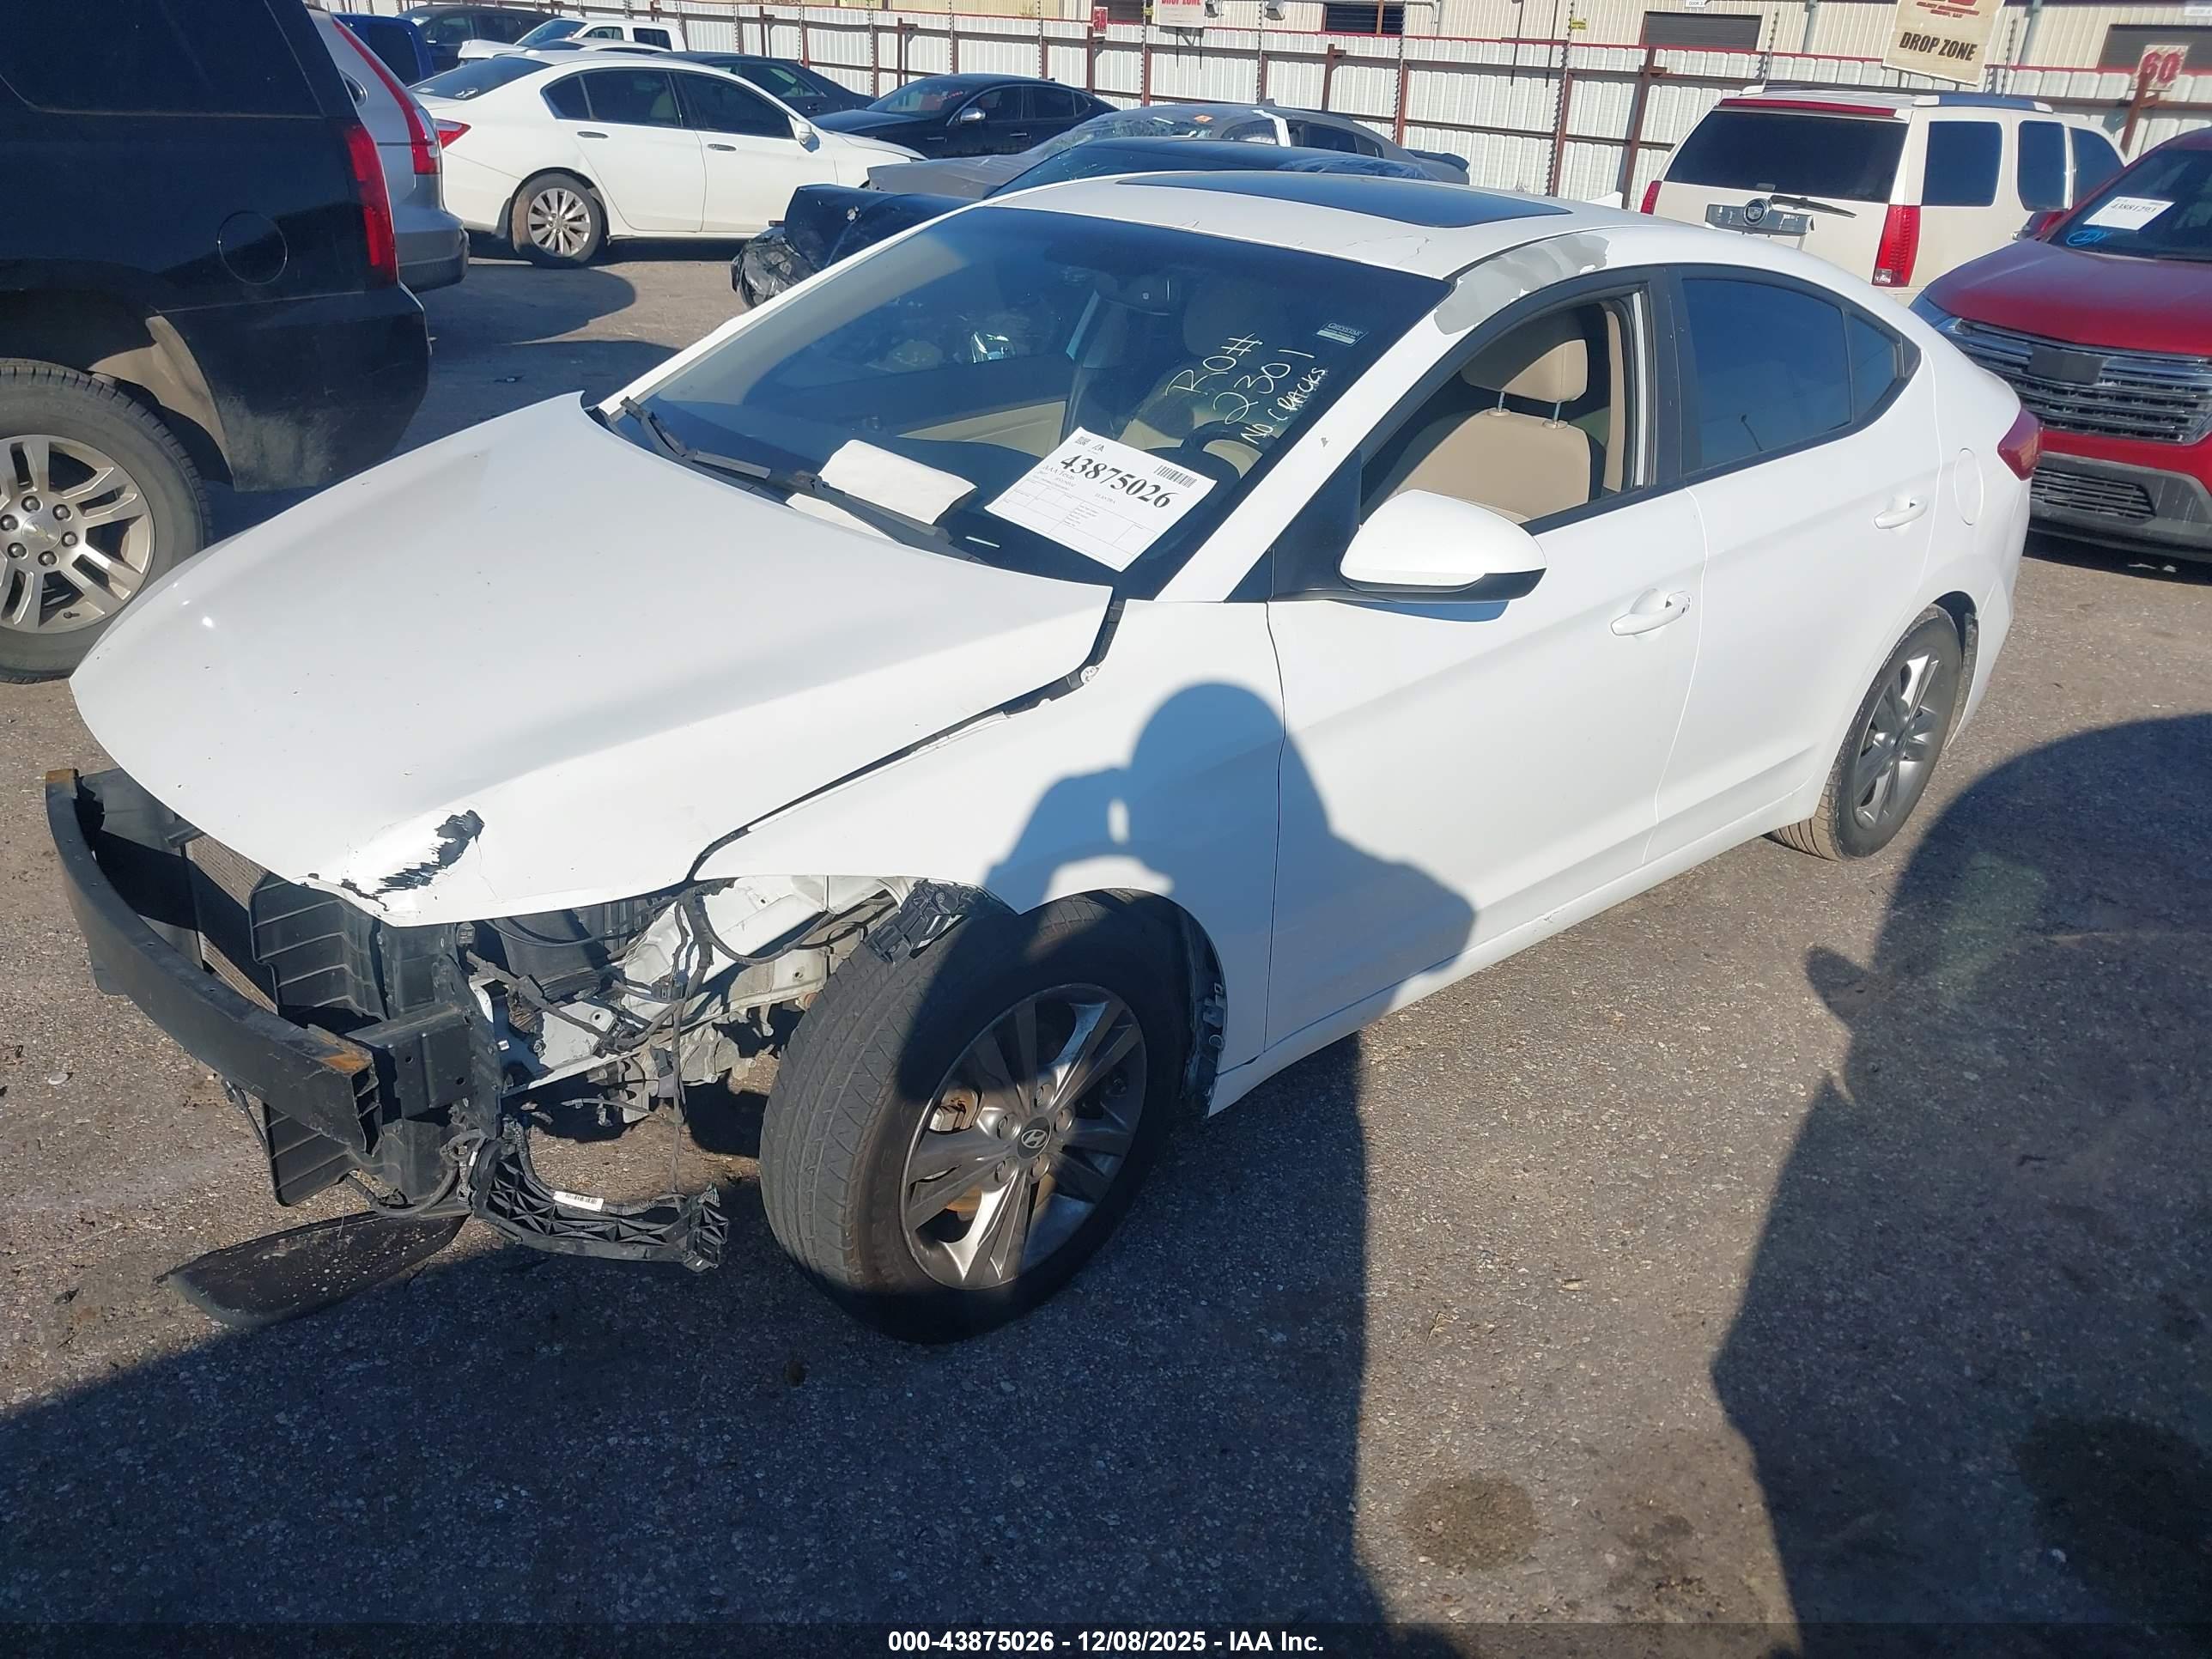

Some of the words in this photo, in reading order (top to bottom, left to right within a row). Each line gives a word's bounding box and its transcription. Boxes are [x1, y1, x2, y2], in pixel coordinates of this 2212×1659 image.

[1899, 31, 1941, 54] DROP
[1938, 39, 1978, 62] ZONE
[2141, 52, 2180, 84] 60
[1212, 349, 1316, 424] 2301
[1060, 454, 1180, 508] 43875026
